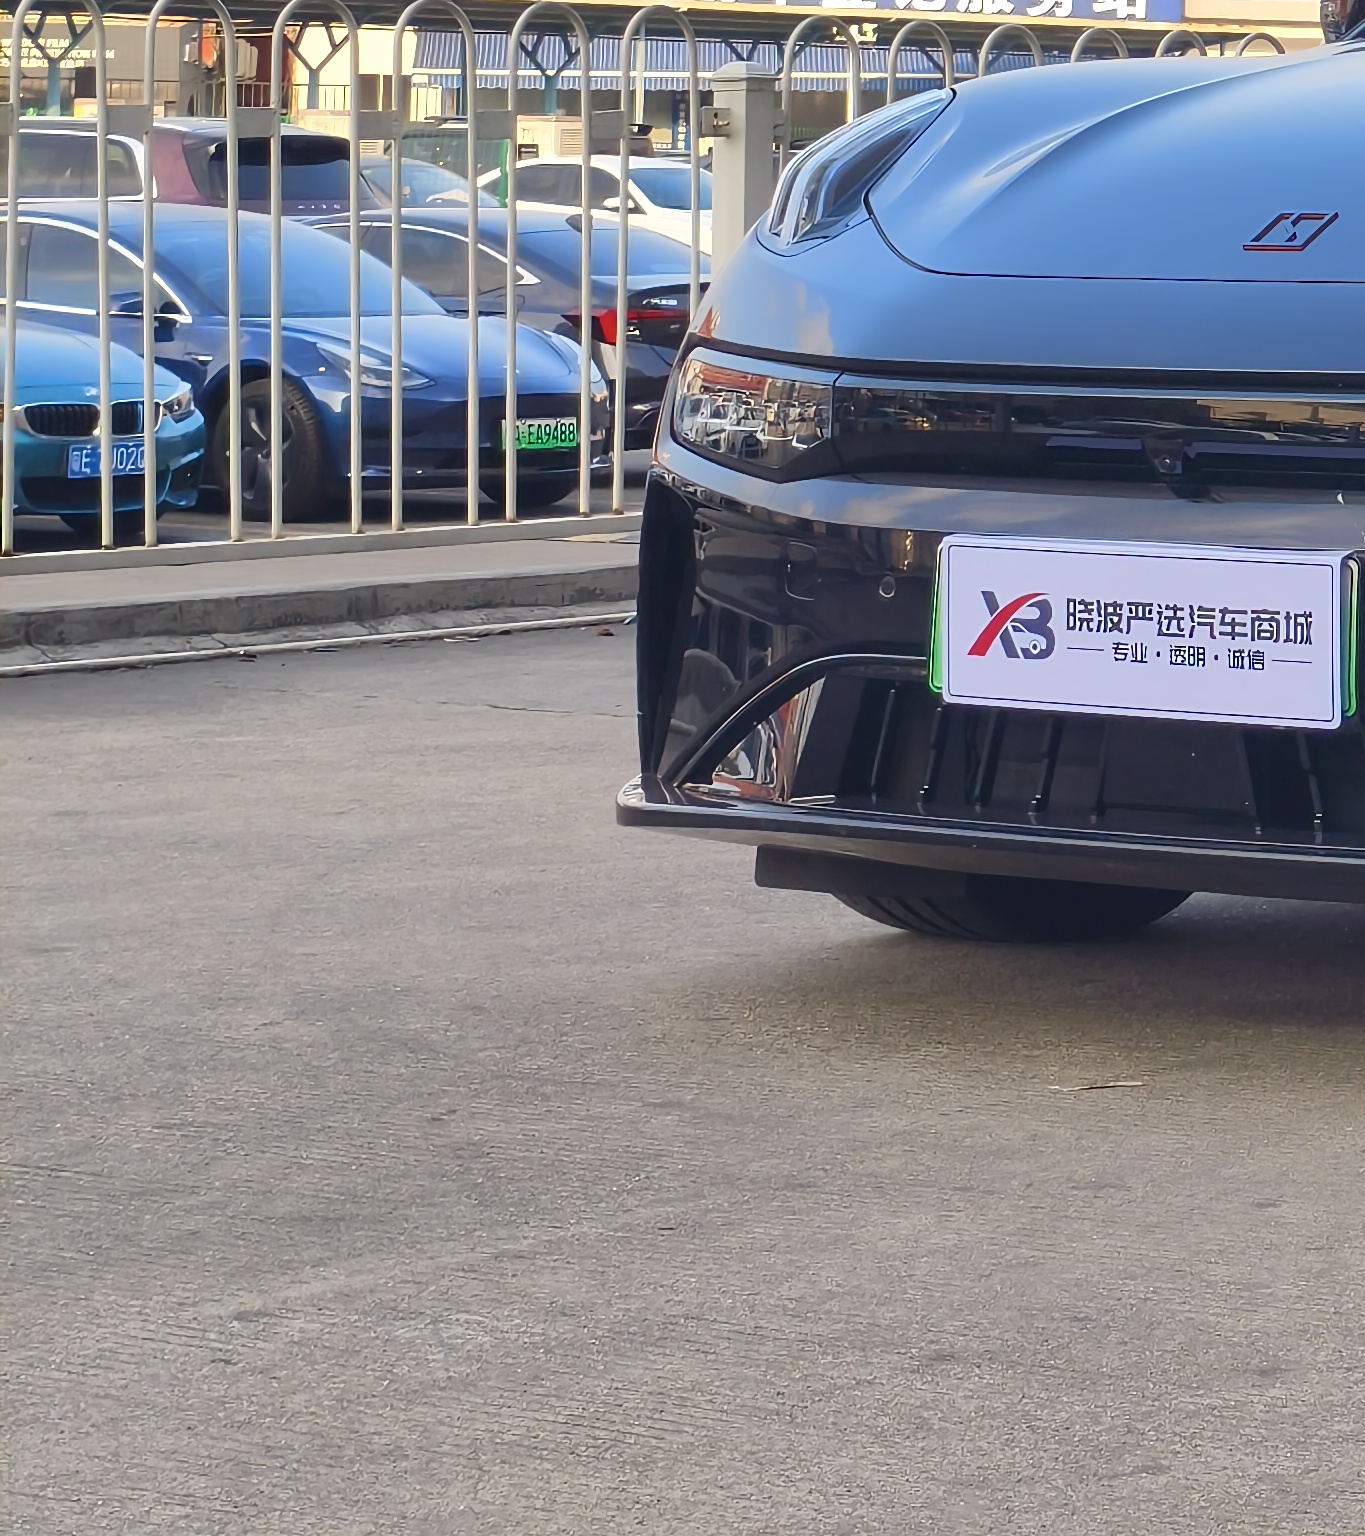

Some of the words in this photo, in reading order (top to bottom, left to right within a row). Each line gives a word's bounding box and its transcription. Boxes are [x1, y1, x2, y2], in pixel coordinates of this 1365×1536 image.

[1066, 597, 1313, 646] 晓波严选汽车商城
